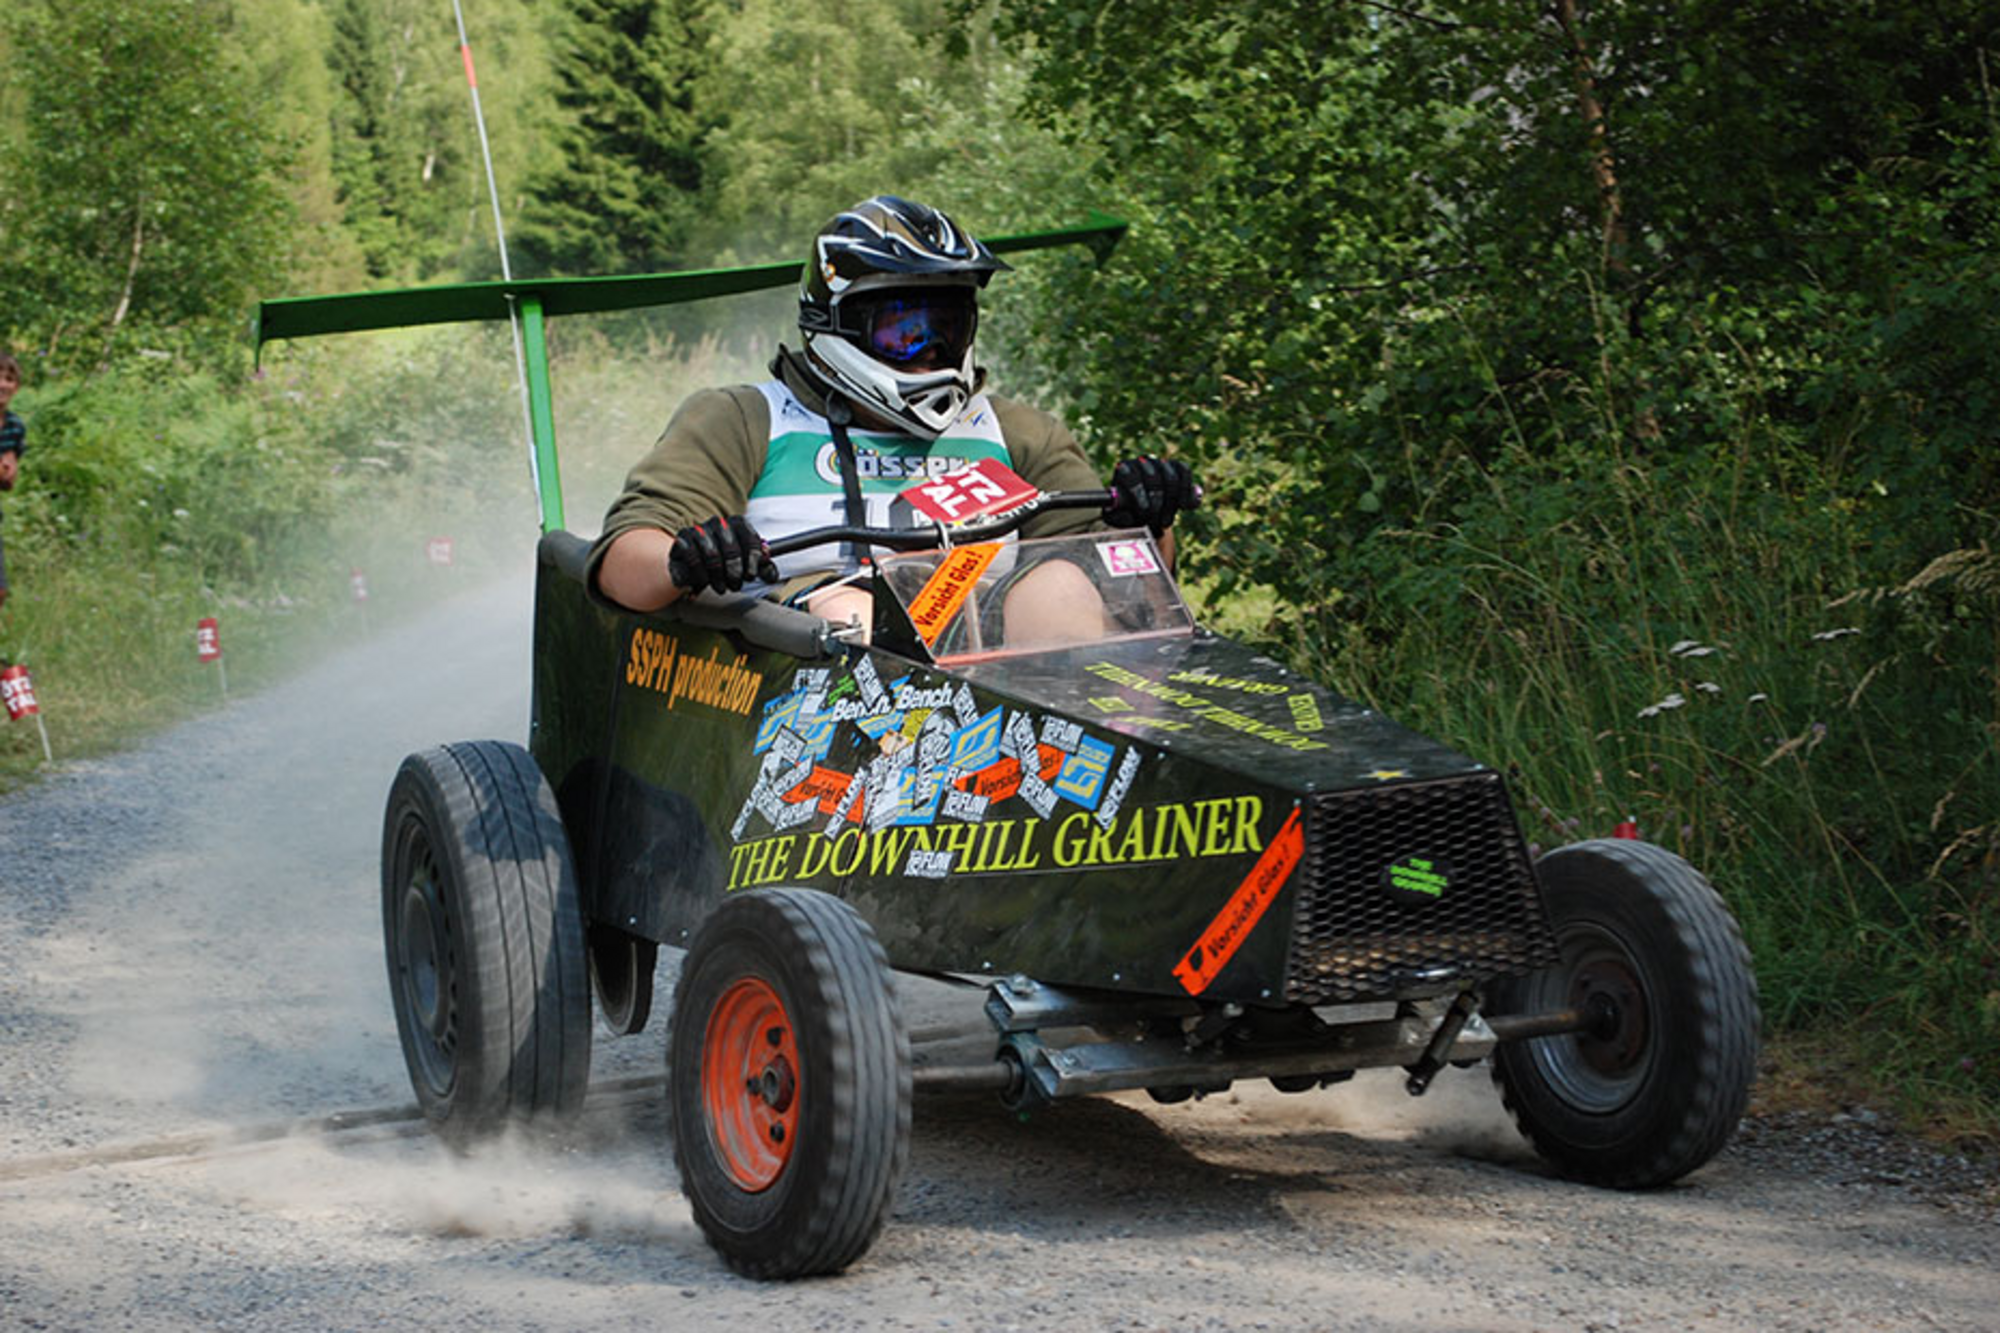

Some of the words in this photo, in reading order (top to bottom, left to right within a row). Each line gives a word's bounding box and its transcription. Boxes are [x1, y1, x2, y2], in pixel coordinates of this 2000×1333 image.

[914, 581, 961, 627] Vorsicht
[626, 627, 678, 693] SSPH
[667, 646, 763, 716] production
[896, 681, 953, 709] Bench
[726, 835, 797, 891] THE
[794, 818, 1040, 881] DOWNHILL
[1052, 795, 1265, 867] GRAINER
[1207, 891, 1258, 959] Vorsicht
